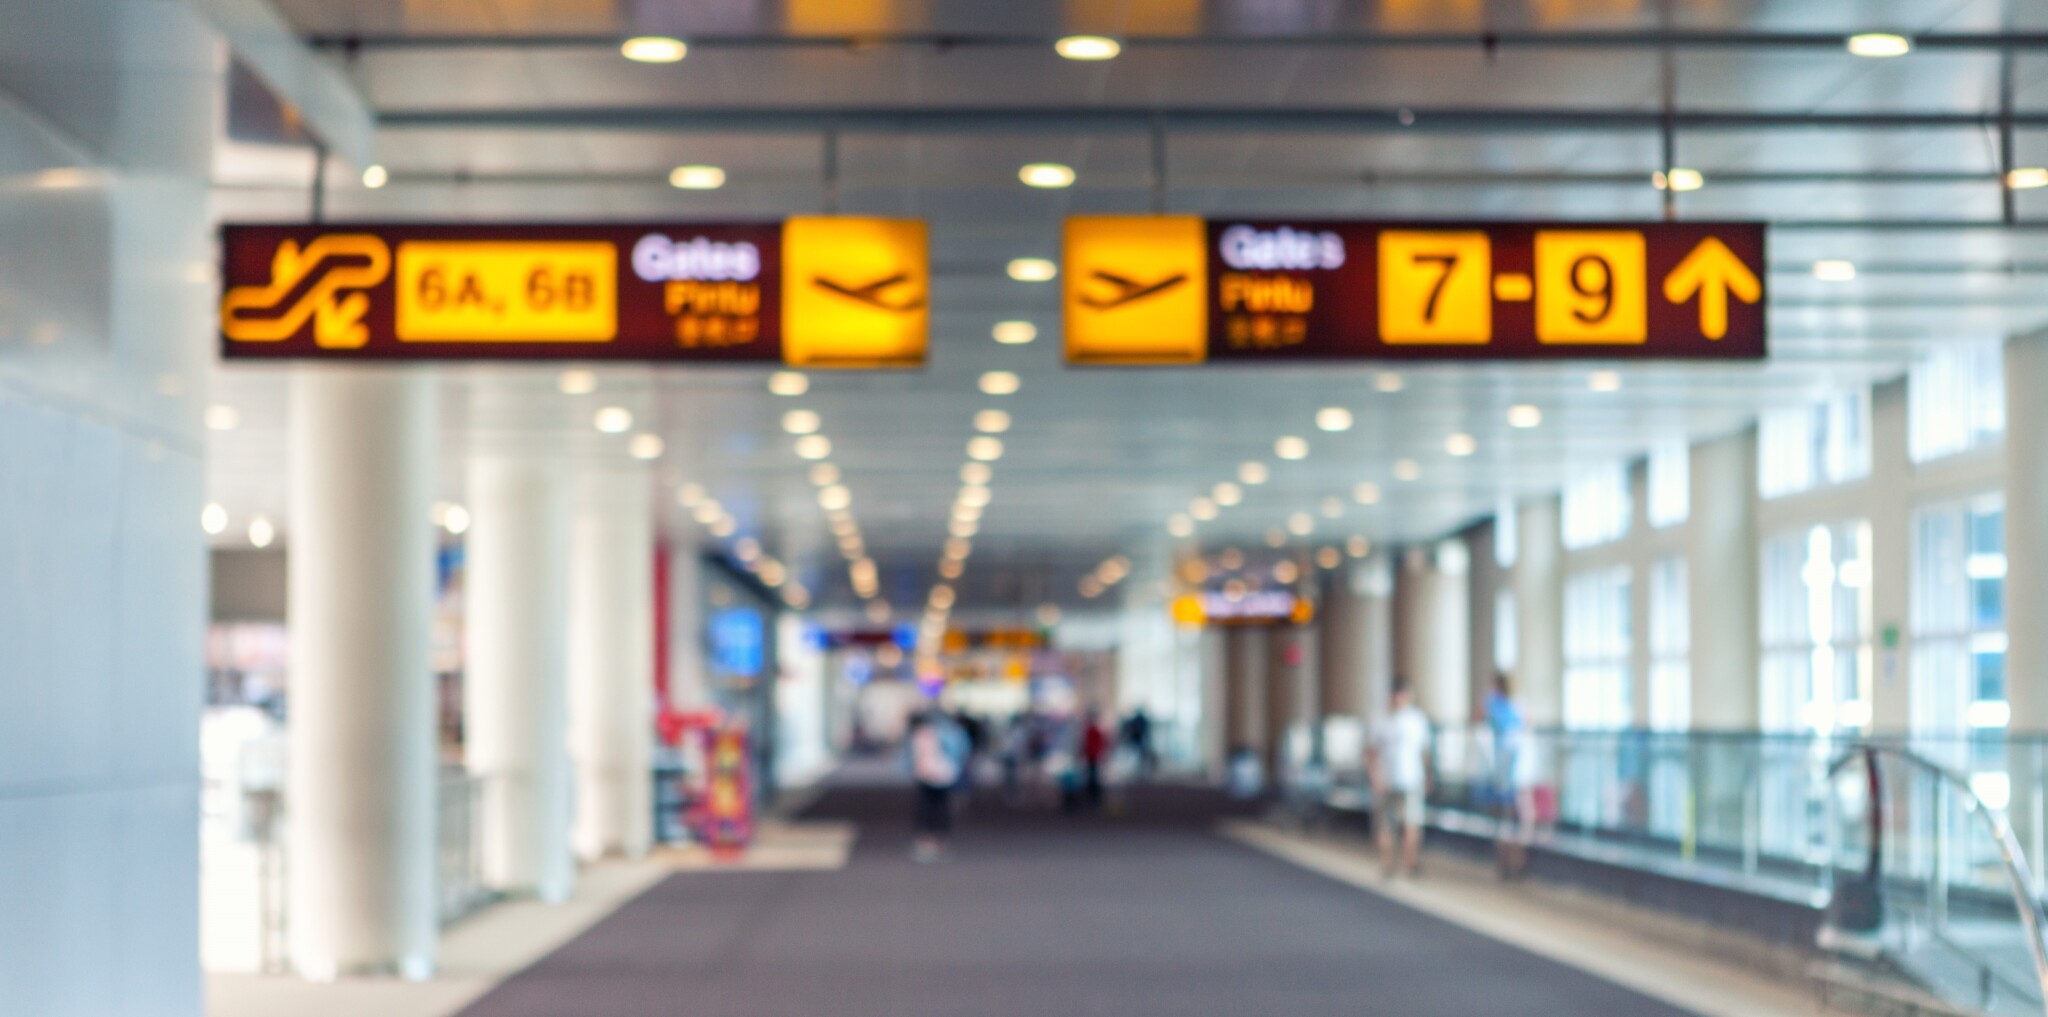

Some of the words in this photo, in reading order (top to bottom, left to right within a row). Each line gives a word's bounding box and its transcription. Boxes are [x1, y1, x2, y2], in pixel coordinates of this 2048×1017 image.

[633, 234, 759, 281] Gates
[1220, 225, 1345, 269] Gates
[415, 266, 507, 319] 6A,
[525, 266, 596, 312] 6B
[1410, 254, 1460, 325] 7
[1569, 254, 1614, 325] 9
